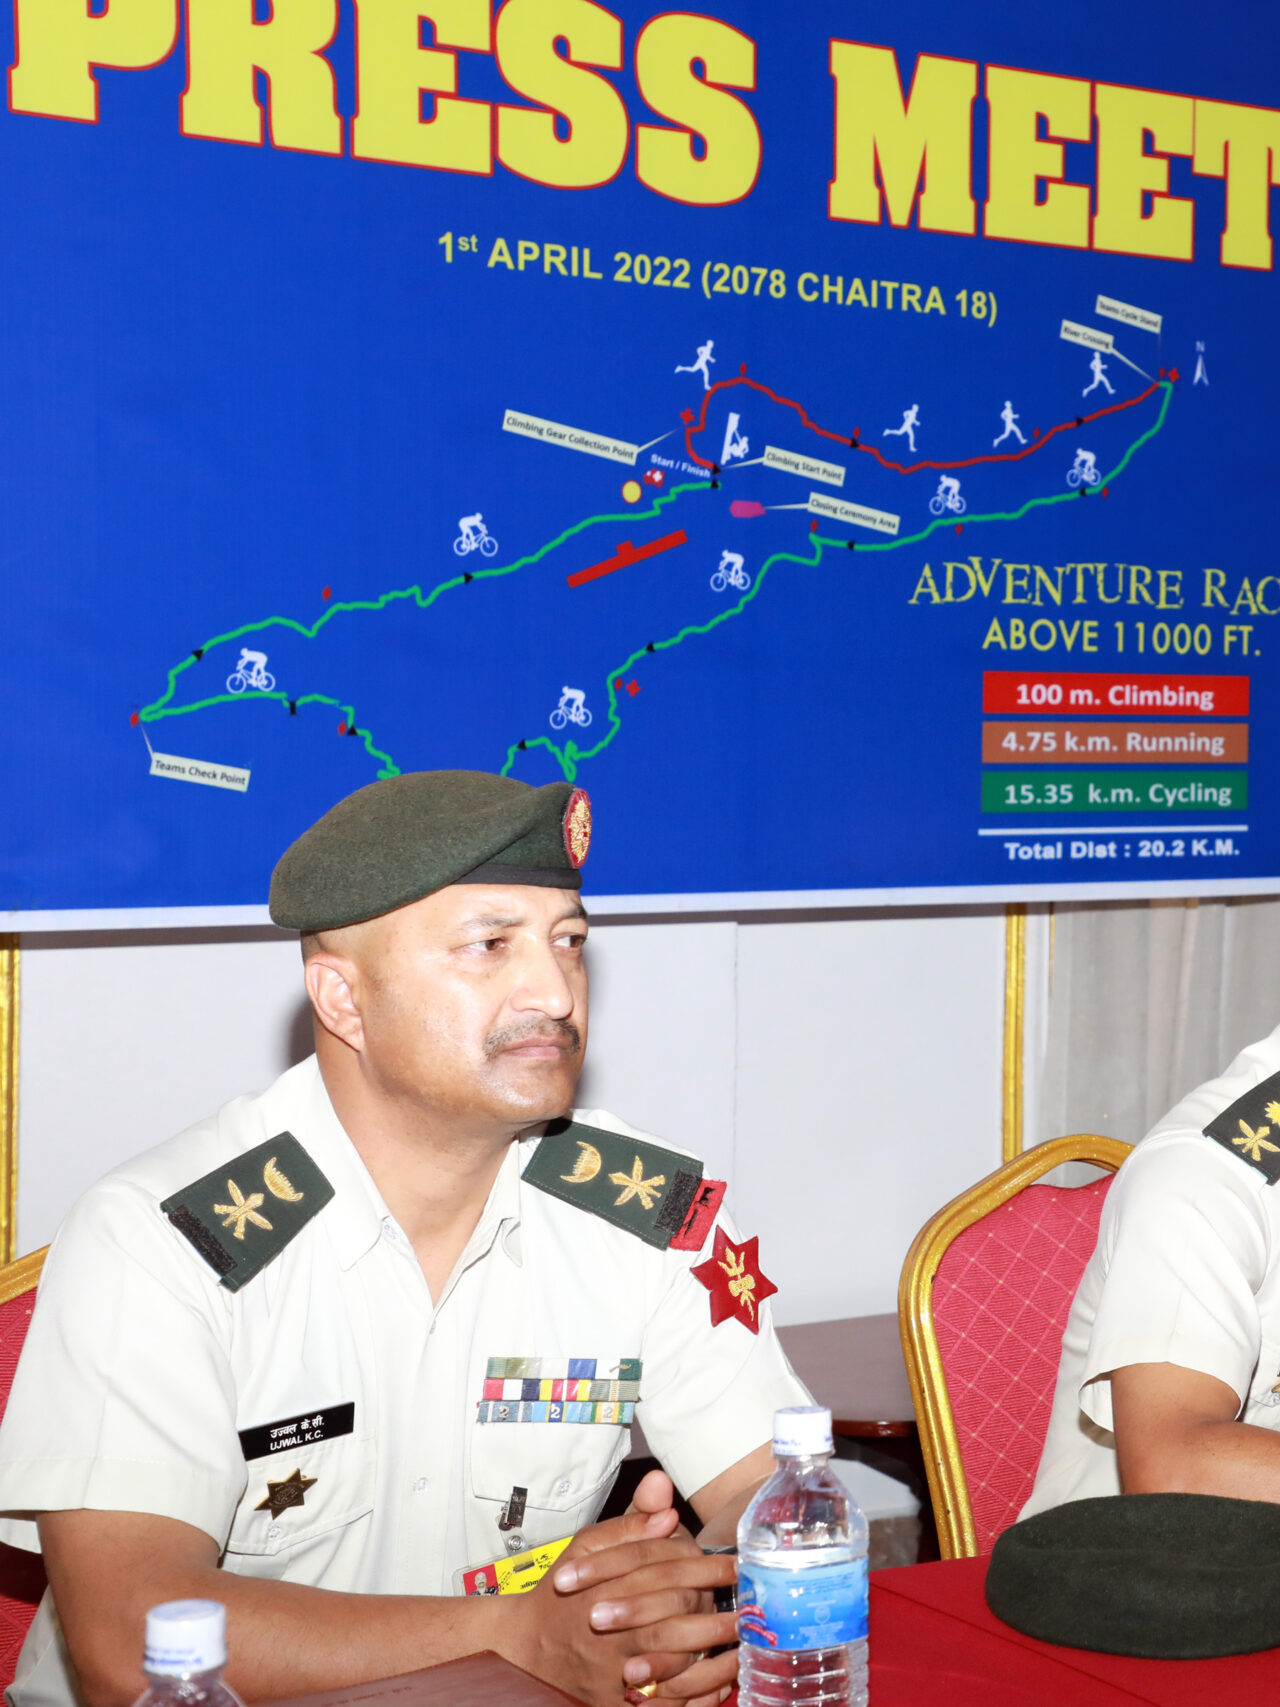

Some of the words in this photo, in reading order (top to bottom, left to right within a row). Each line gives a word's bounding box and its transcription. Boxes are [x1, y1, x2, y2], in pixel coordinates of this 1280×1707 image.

[8, 0, 762, 207] PRESS
[438, 231, 478, 263] 1st
[487, 237, 603, 279] APRIL
[613, 251, 691, 289] 2022
[702, 261, 787, 299] (2078
[797, 272, 947, 315] CHAITRA
[955, 289, 997, 328] 18)
[1063, 326, 1081, 338] River
[1082, 332, 1110, 349] Crossing
[506, 416, 544, 436] Climbing
[546, 427, 566, 440] Gear
[568, 433, 611, 453] Collection
[612, 446, 634, 460] Point
[651, 454, 675, 469] Start
[681, 461, 711, 478] Finish
[766, 452, 799, 470] Climbing
[802, 463, 820, 475] Start
[822, 468, 842, 480] Point
[811, 499, 838, 514] Closing
[840, 507, 877, 523] Ceremony
[879, 518, 896, 528] Area
[908, 556, 1185, 610] ADVENTURE
[982, 616, 1099, 653] ABOVE
[1114, 621, 1212, 656] 11000
[1223, 625, 1261, 656] FT.
[1016, 683, 1063, 706] 100
[1069, 688, 1101, 706] m.
[1108, 684, 1215, 711] Climbing
[1002, 731, 1057, 752] 4.75
[1064, 731, 1119, 753] k.m.
[1126, 732, 1225, 757] Running
[155, 760, 186, 774] Teams
[188, 766, 218, 780] Check
[220, 772, 246, 785] Point
[1004, 784, 1074, 805] 15.35
[1088, 783, 1141, 804] k.m.
[1148, 783, 1232, 808] Cycling
[1004, 842, 1063, 861] Total
[1070, 842, 1118, 860] Dist
[1138, 840, 1185, 858] 20.2
[1192, 838, 1240, 856] K.M.
[270, 1435, 302, 1450] UJWAL
[305, 1430, 324, 1441] K.C.
